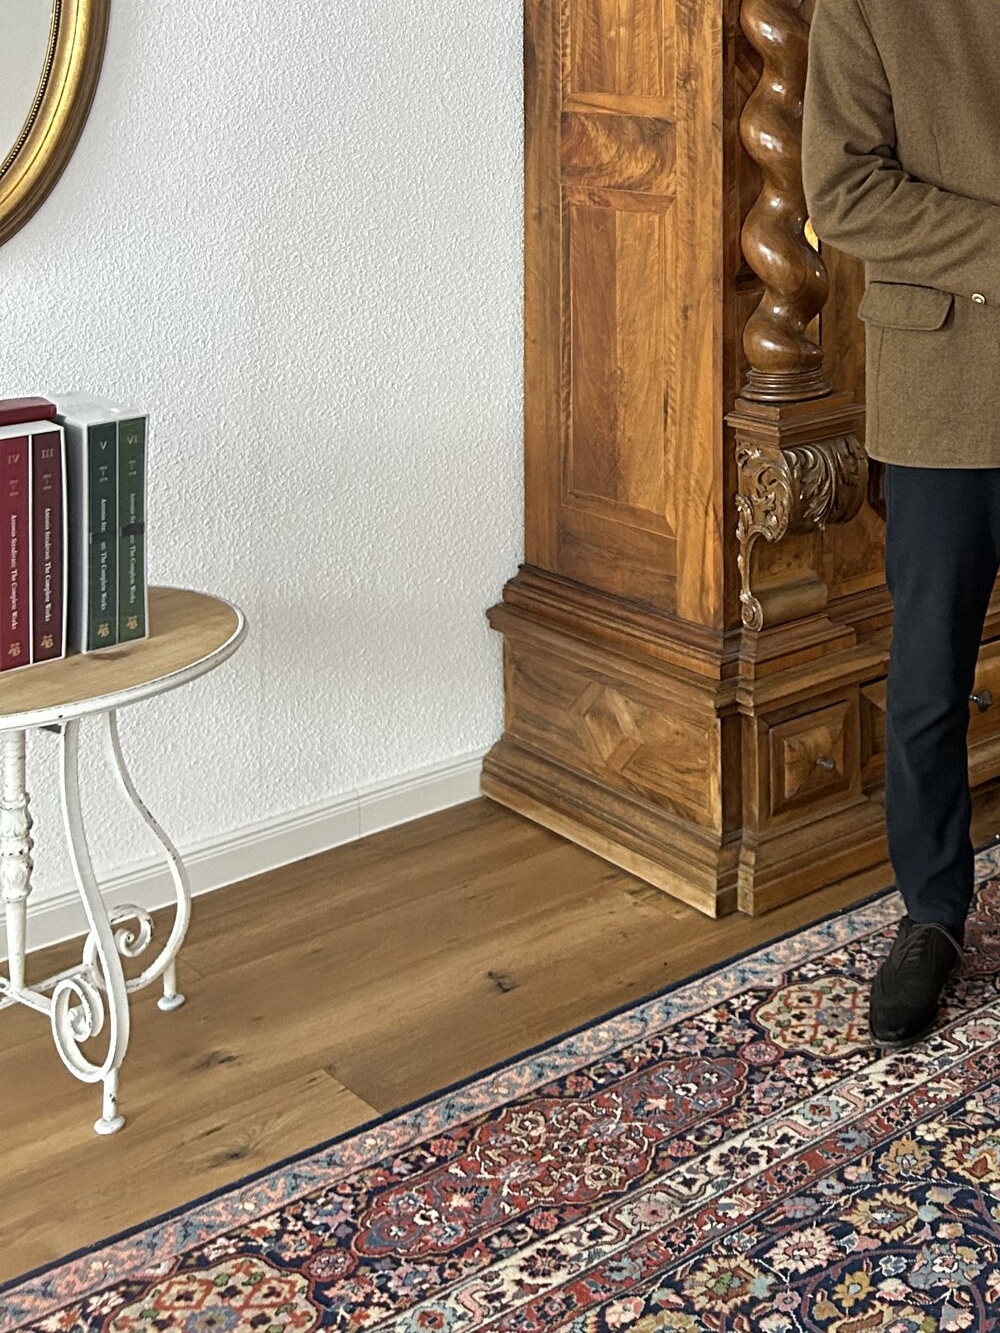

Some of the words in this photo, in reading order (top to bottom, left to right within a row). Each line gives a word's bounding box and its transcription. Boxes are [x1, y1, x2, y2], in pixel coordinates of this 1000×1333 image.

[126, 435, 139, 445] VI
[99, 441, 108, 450] V
[41, 448, 55, 459] III
[7, 454, 21, 464] IV
